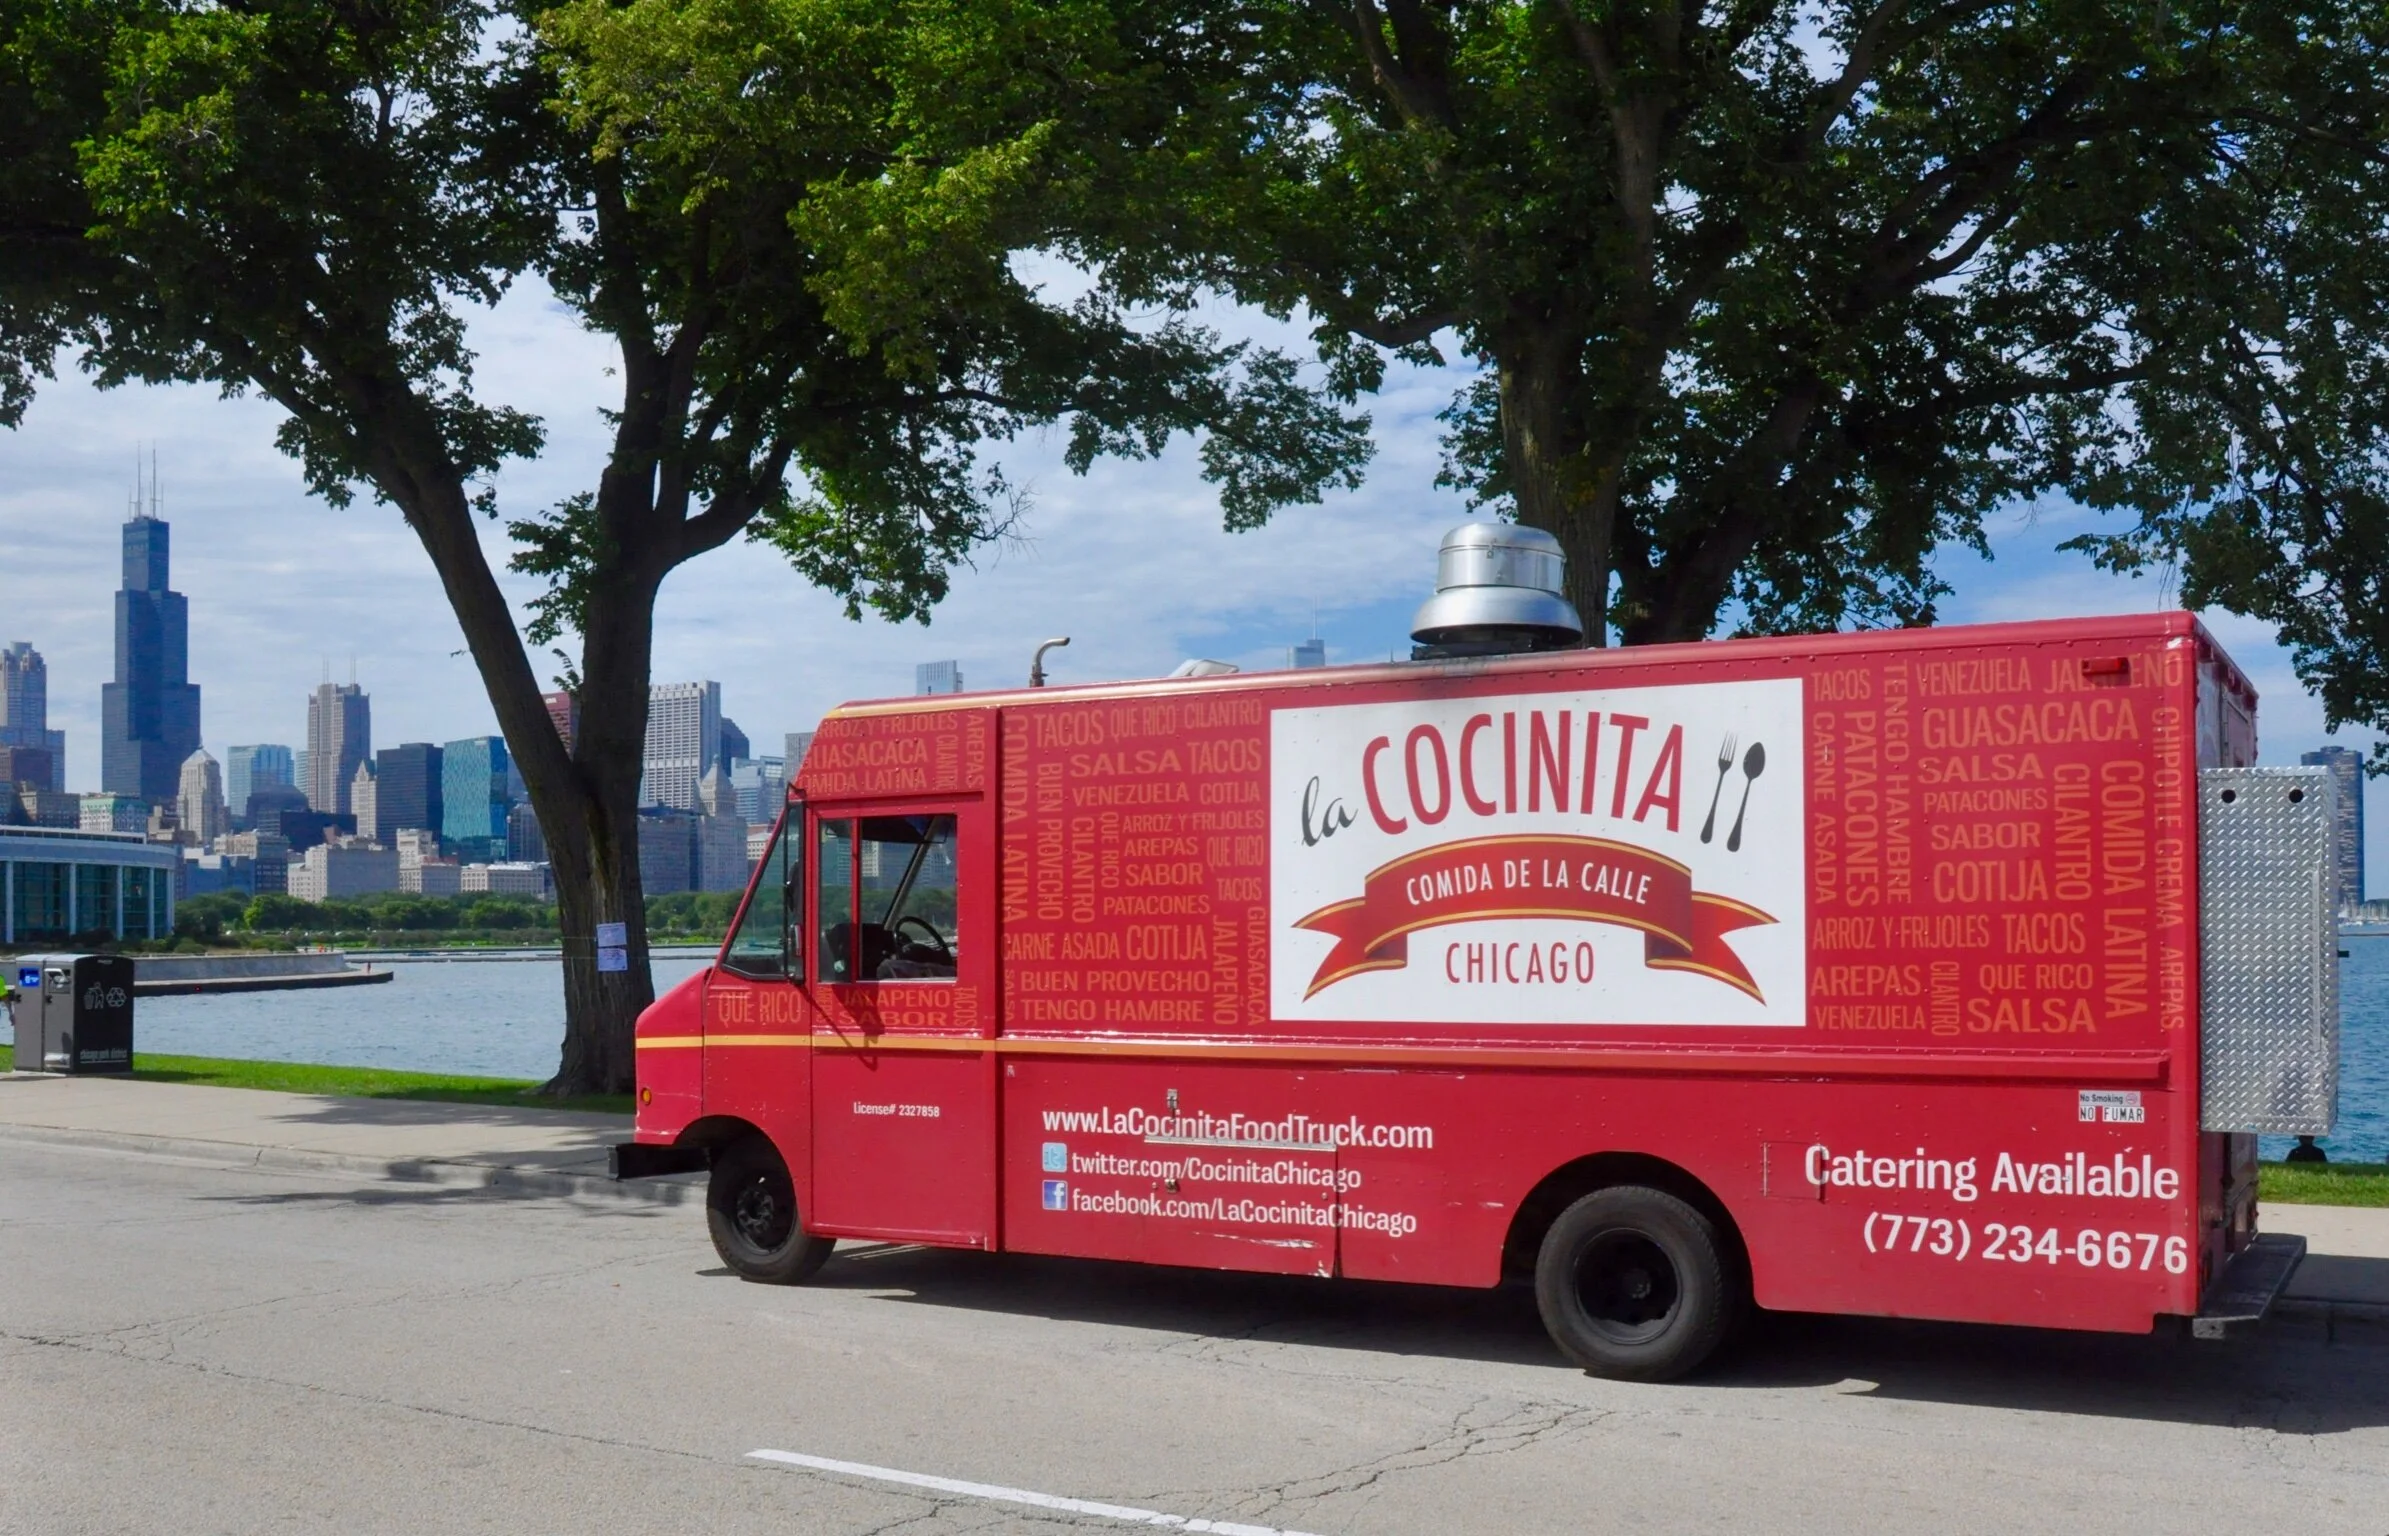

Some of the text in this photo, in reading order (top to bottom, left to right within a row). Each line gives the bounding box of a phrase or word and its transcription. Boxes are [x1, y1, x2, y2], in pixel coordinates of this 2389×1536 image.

[1810, 668, 1871, 701] TACOS
[1916, 645, 2183, 697] VENEZUELA JALEÑO
[882, 713, 957, 734] FRIJOLES
[1034, 710, 1104, 747] TACOS
[1110, 704, 1176, 742] QUE RICO
[1184, 700, 1262, 729] CILANTRO
[1923, 699, 2138, 749] GUASACACA
[966, 715, 985, 787] AREPAS
[1004, 715, 1028, 823] COMIDA
[1070, 749, 1182, 777] SALSA
[1187, 738, 1261, 774] TACOS
[1917, 753, 2044, 784] SALSA
[865, 768, 927, 791] LATINA
[1072, 782, 1190, 806] VENEZUELA
[1201, 781, 1261, 805] COTIJA
[1301, 710, 1683, 847] la COCINITA
[1884, 660, 1911, 904] TENGO HAMBRE
[1813, 711, 1836, 904] CARNE ASADA
[1844, 710, 1879, 907] PATACONES
[1924, 788, 2048, 814] PATACONES
[1122, 810, 1265, 833] ARROZ Y FRIJOLES
[1931, 822, 2041, 851] SABOR
[2054, 764, 2092, 901] CILANTRO
[1037, 762, 1063, 920] BUEN PROVECHO
[1101, 812, 1119, 888] QUE RICO
[1124, 837, 1198, 857] AREPAS
[1207, 835, 1264, 872] QUE RICO
[1072, 817, 1095, 923] CILANTRO
[1126, 863, 1203, 886] SABOR
[1407, 859, 1651, 906] COMIDA DE LA CALLE
[1933, 860, 2048, 903] COTIJA
[2152, 706, 2184, 1029] CHIPOTLE CREMA AREPAS
[1103, 895, 1210, 915] PATACONES
[1217, 877, 1262, 901] TACOS
[2101, 760, 2148, 1018] COMIDA LATINA
[1003, 932, 1120, 960] CARNE ASADA
[1126, 925, 1207, 960] COTIJA
[1812, 915, 1989, 949] ARROZ Y FRIJOLES
[2001, 913, 2085, 954] TACOS
[1021, 970, 1210, 992] BUEN PROVECHO
[1213, 915, 1244, 1025] JALAPEÑO
[1248, 906, 1266, 1026] GUASACACA
[1446, 942, 1595, 984] CHICAGO
[1811, 965, 1921, 996] AREPAS
[1980, 963, 2093, 994] QUE RICO
[718, 990, 800, 1027] QUE RICO
[953, 986, 978, 1027] TACOS
[1021, 1000, 1204, 1022] TENGO HAMBRE
[1930, 961, 1960, 1036] CILANTRO
[1967, 999, 2097, 1033] SALSA
[838, 1011, 947, 1026] SABOR
[1815, 1005, 1926, 1030] VENEZUELA
[853, 1102, 940, 1118] License# 2327858
[2080, 1107, 2143, 1121] NO FUMAR
[2092, 1094, 2123, 1104] Smoking
[1042, 1107, 1433, 1149] www.LaCocinitaFoodTruck.com
[1072, 1152, 1361, 1193] twitter.com/CocinitaChicago
[1806, 1144, 2179, 1201] Catering Available
[1072, 1188, 1417, 1238] facebook.com/LaCocinitaChicago
[1864, 1211, 2188, 1274] (773) 234-6676
